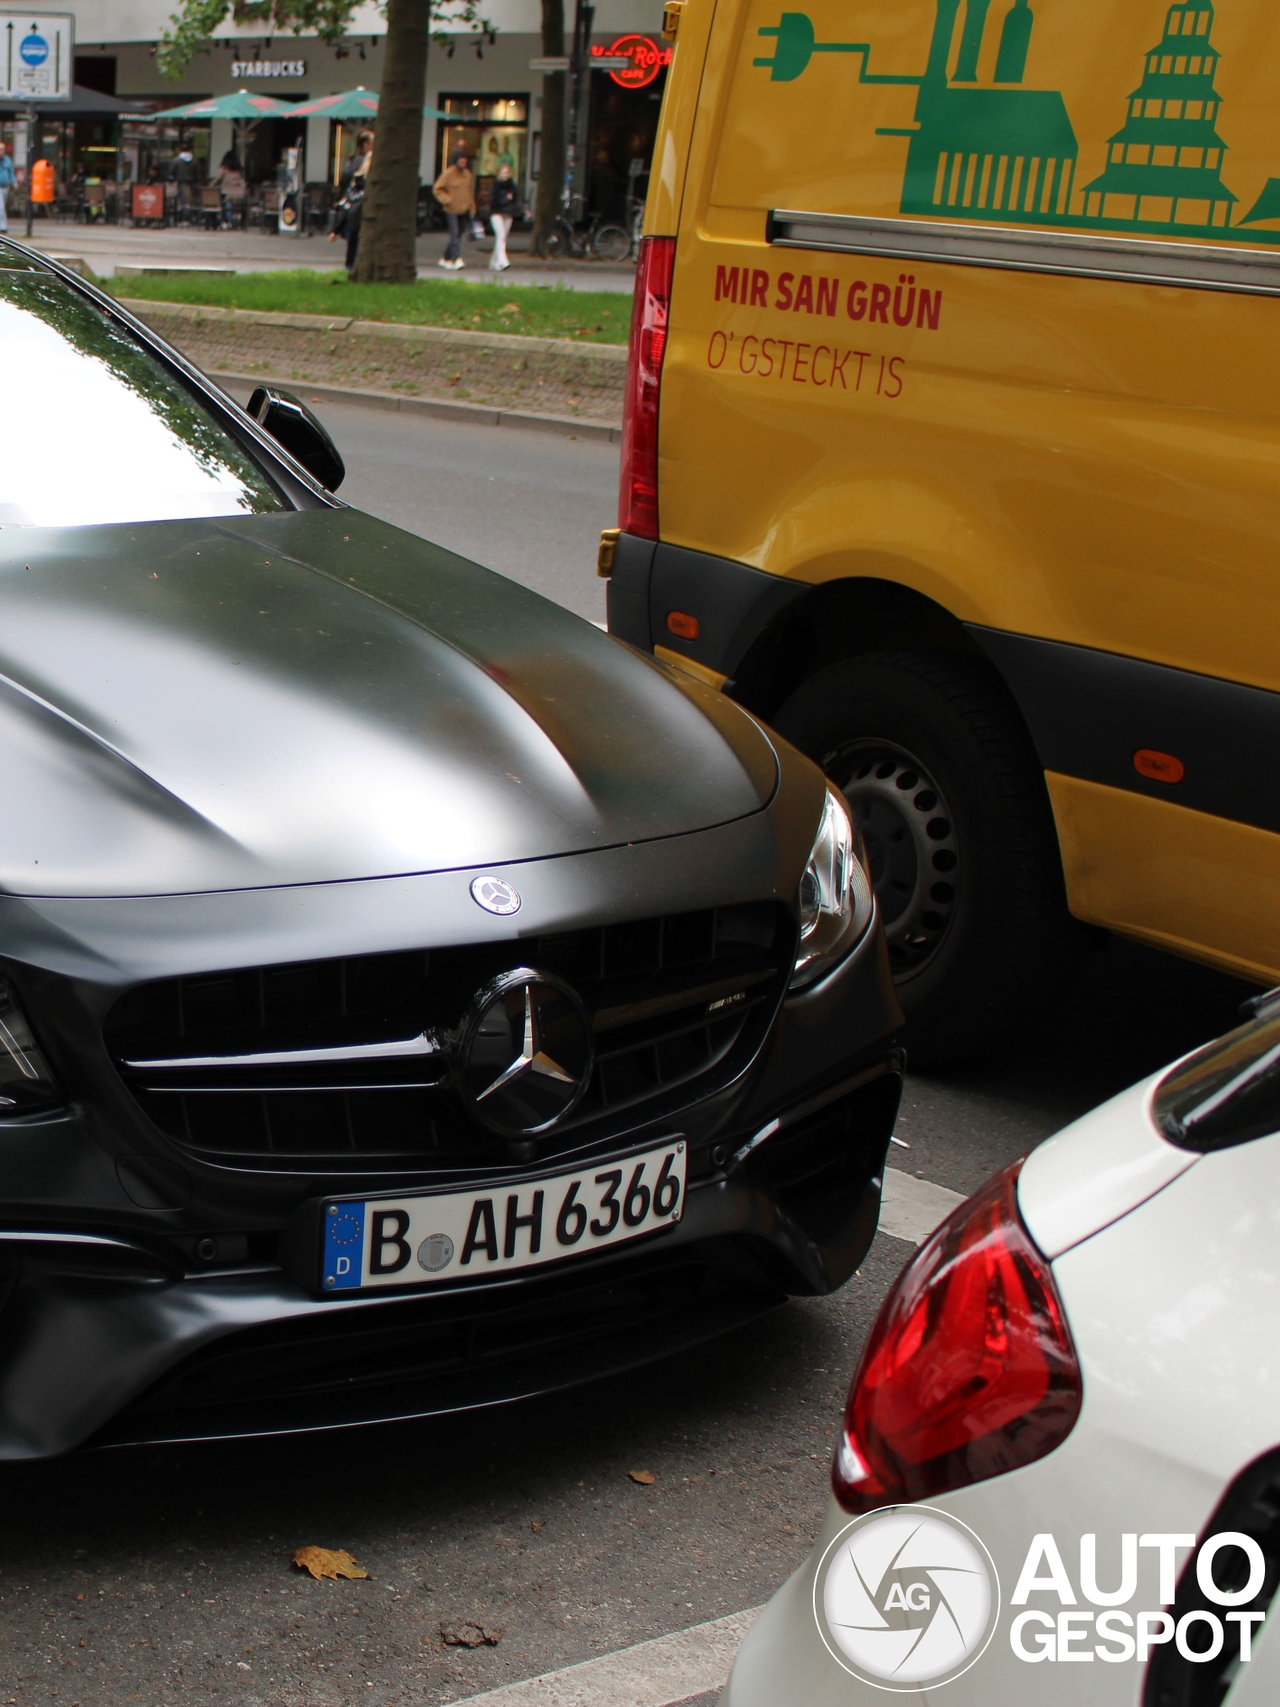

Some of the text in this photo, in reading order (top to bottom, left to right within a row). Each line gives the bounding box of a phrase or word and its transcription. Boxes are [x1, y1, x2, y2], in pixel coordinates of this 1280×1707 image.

[231, 61, 305, 77] STARBUCKS
[620, 69, 645, 78] CAFE
[714, 264, 943, 331] MIR SAN GRÜN
[739, 335, 872, 392] GSTECKT
[876, 355, 906, 398] IS
[369, 1152, 680, 1275] B AH 6366
[335, 1257, 351, 1275] D
